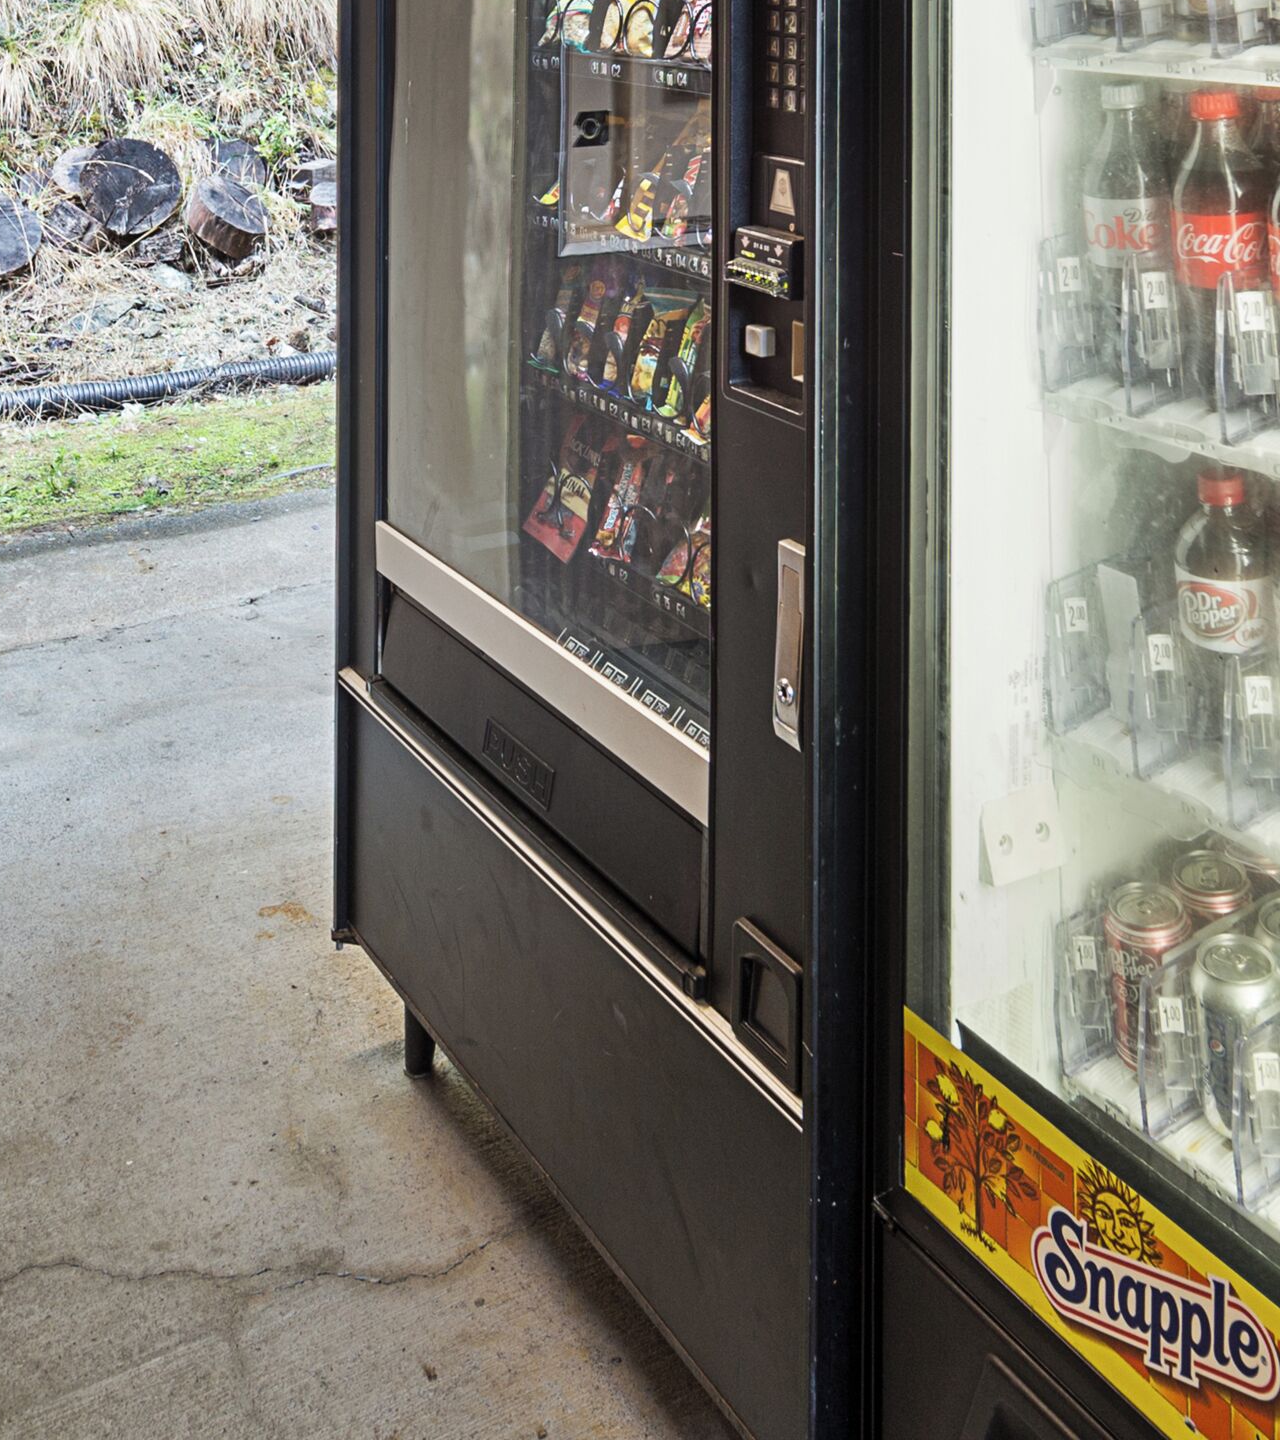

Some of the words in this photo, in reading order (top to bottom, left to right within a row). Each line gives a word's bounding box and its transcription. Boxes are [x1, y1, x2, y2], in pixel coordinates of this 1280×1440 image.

[1265, 70, 1280, 83] B3
[1177, 222, 1269, 264] Coca-Col
[1183, 592, 1240, 628] Pepper
[1197, 591, 1222, 610] Dr
[487, 728, 549, 805] PUSH
[1119, 948, 1140, 965] Dr
[1044, 1211, 1261, 1380] Snapple
